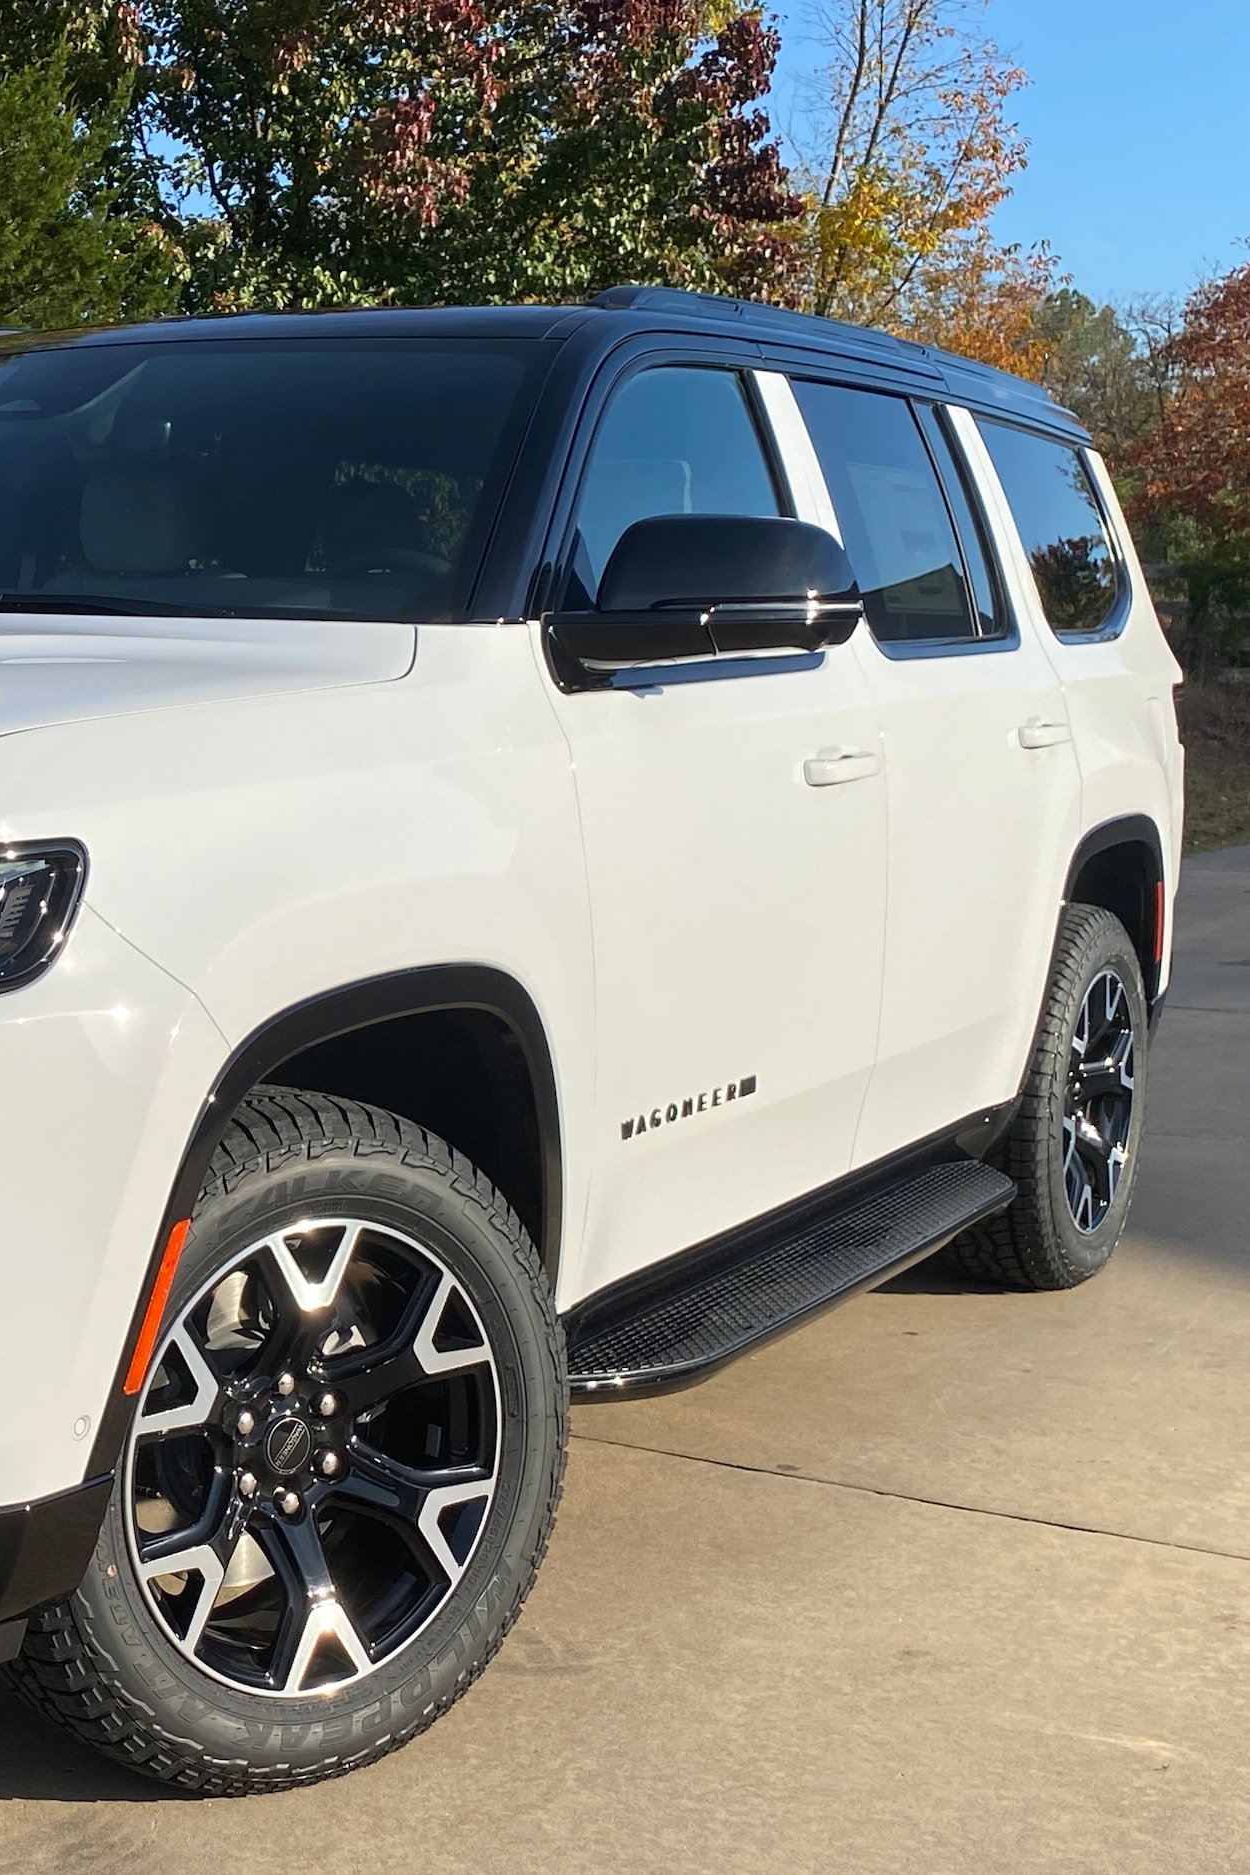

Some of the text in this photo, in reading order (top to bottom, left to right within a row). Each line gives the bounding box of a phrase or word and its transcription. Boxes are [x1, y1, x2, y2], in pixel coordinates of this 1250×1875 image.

[620, 1083, 737, 1140] WAGONEER
[218, 1170, 444, 1240] FALKEN
[274, 1424, 304, 1467] WAGONEER
[231, 1555, 515, 1751] WILDPEAK
